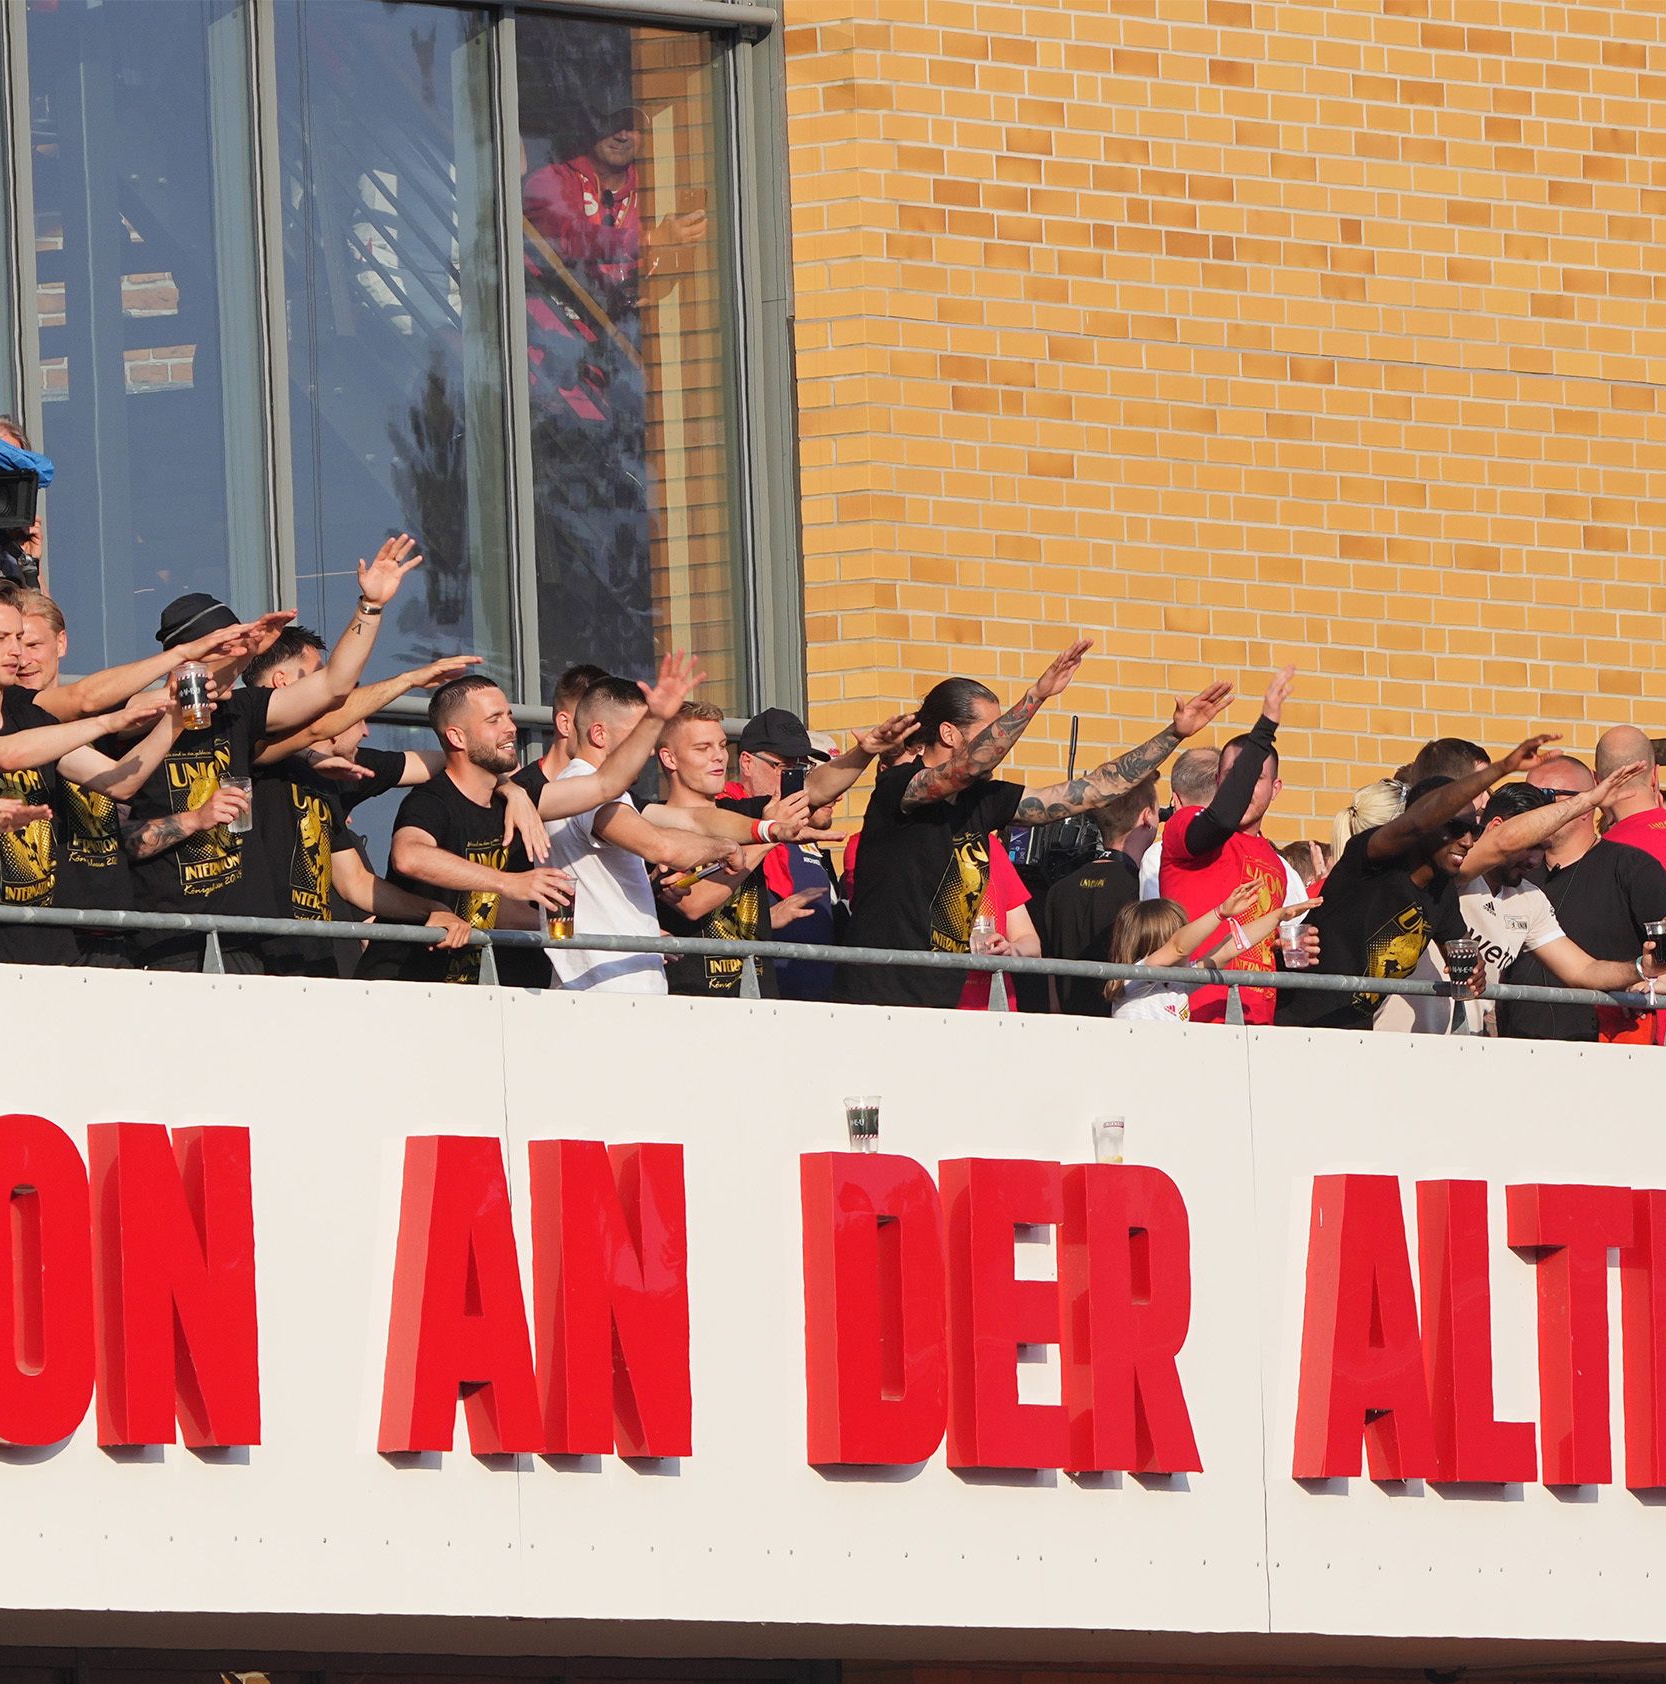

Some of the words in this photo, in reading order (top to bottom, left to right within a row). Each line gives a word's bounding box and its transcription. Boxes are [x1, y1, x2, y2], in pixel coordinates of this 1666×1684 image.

[168, 746, 231, 788] UNION
[377, 1135, 693, 1457] AN
[800, 1151, 1204, 1473] DER
